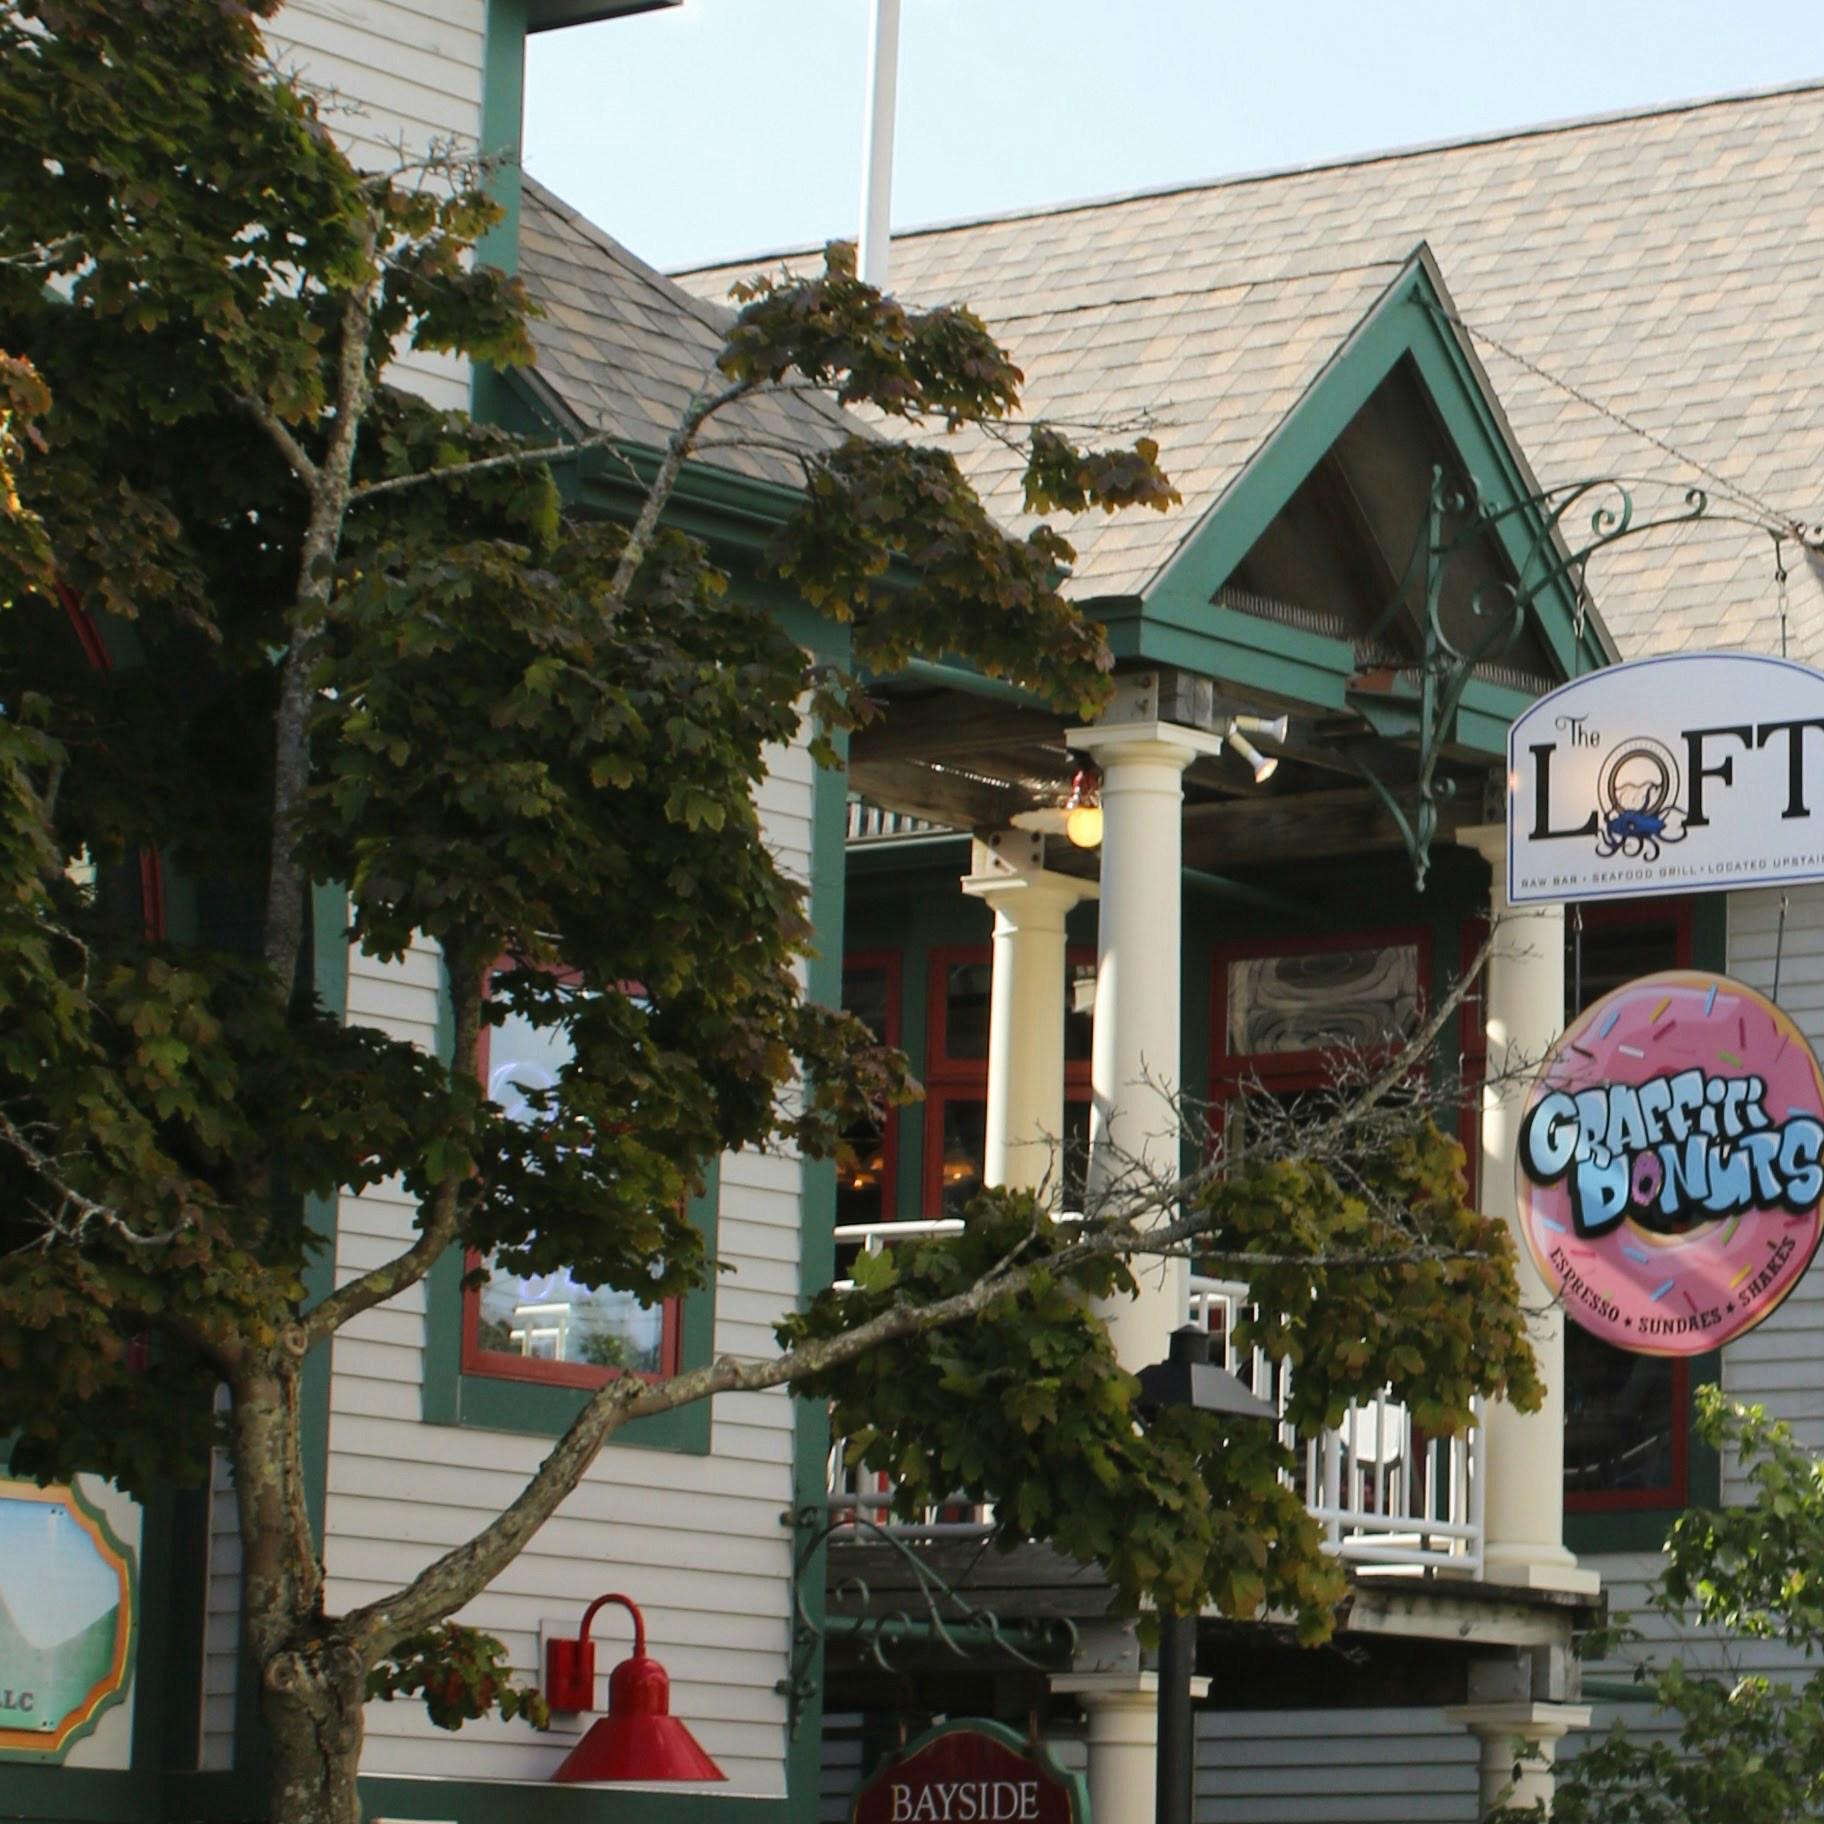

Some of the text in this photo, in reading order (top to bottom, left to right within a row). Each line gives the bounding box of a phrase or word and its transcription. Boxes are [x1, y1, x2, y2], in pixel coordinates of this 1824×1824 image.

[1555, 712, 1600, 748] The
[1520, 877, 1547, 889] RAW
[1552, 874, 1578, 886] BAR
[1592, 869, 1653, 884] SEAFOOD
[1659, 864, 1697, 878] GRILL
[1708, 858, 1767, 875] LOCATED
[1549, 1235, 1797, 1335] ESPRESSO SUNDAES SHAKES
[0, 1689, 34, 1712] LC
[890, 1781, 1040, 1823] BAYSIDE
